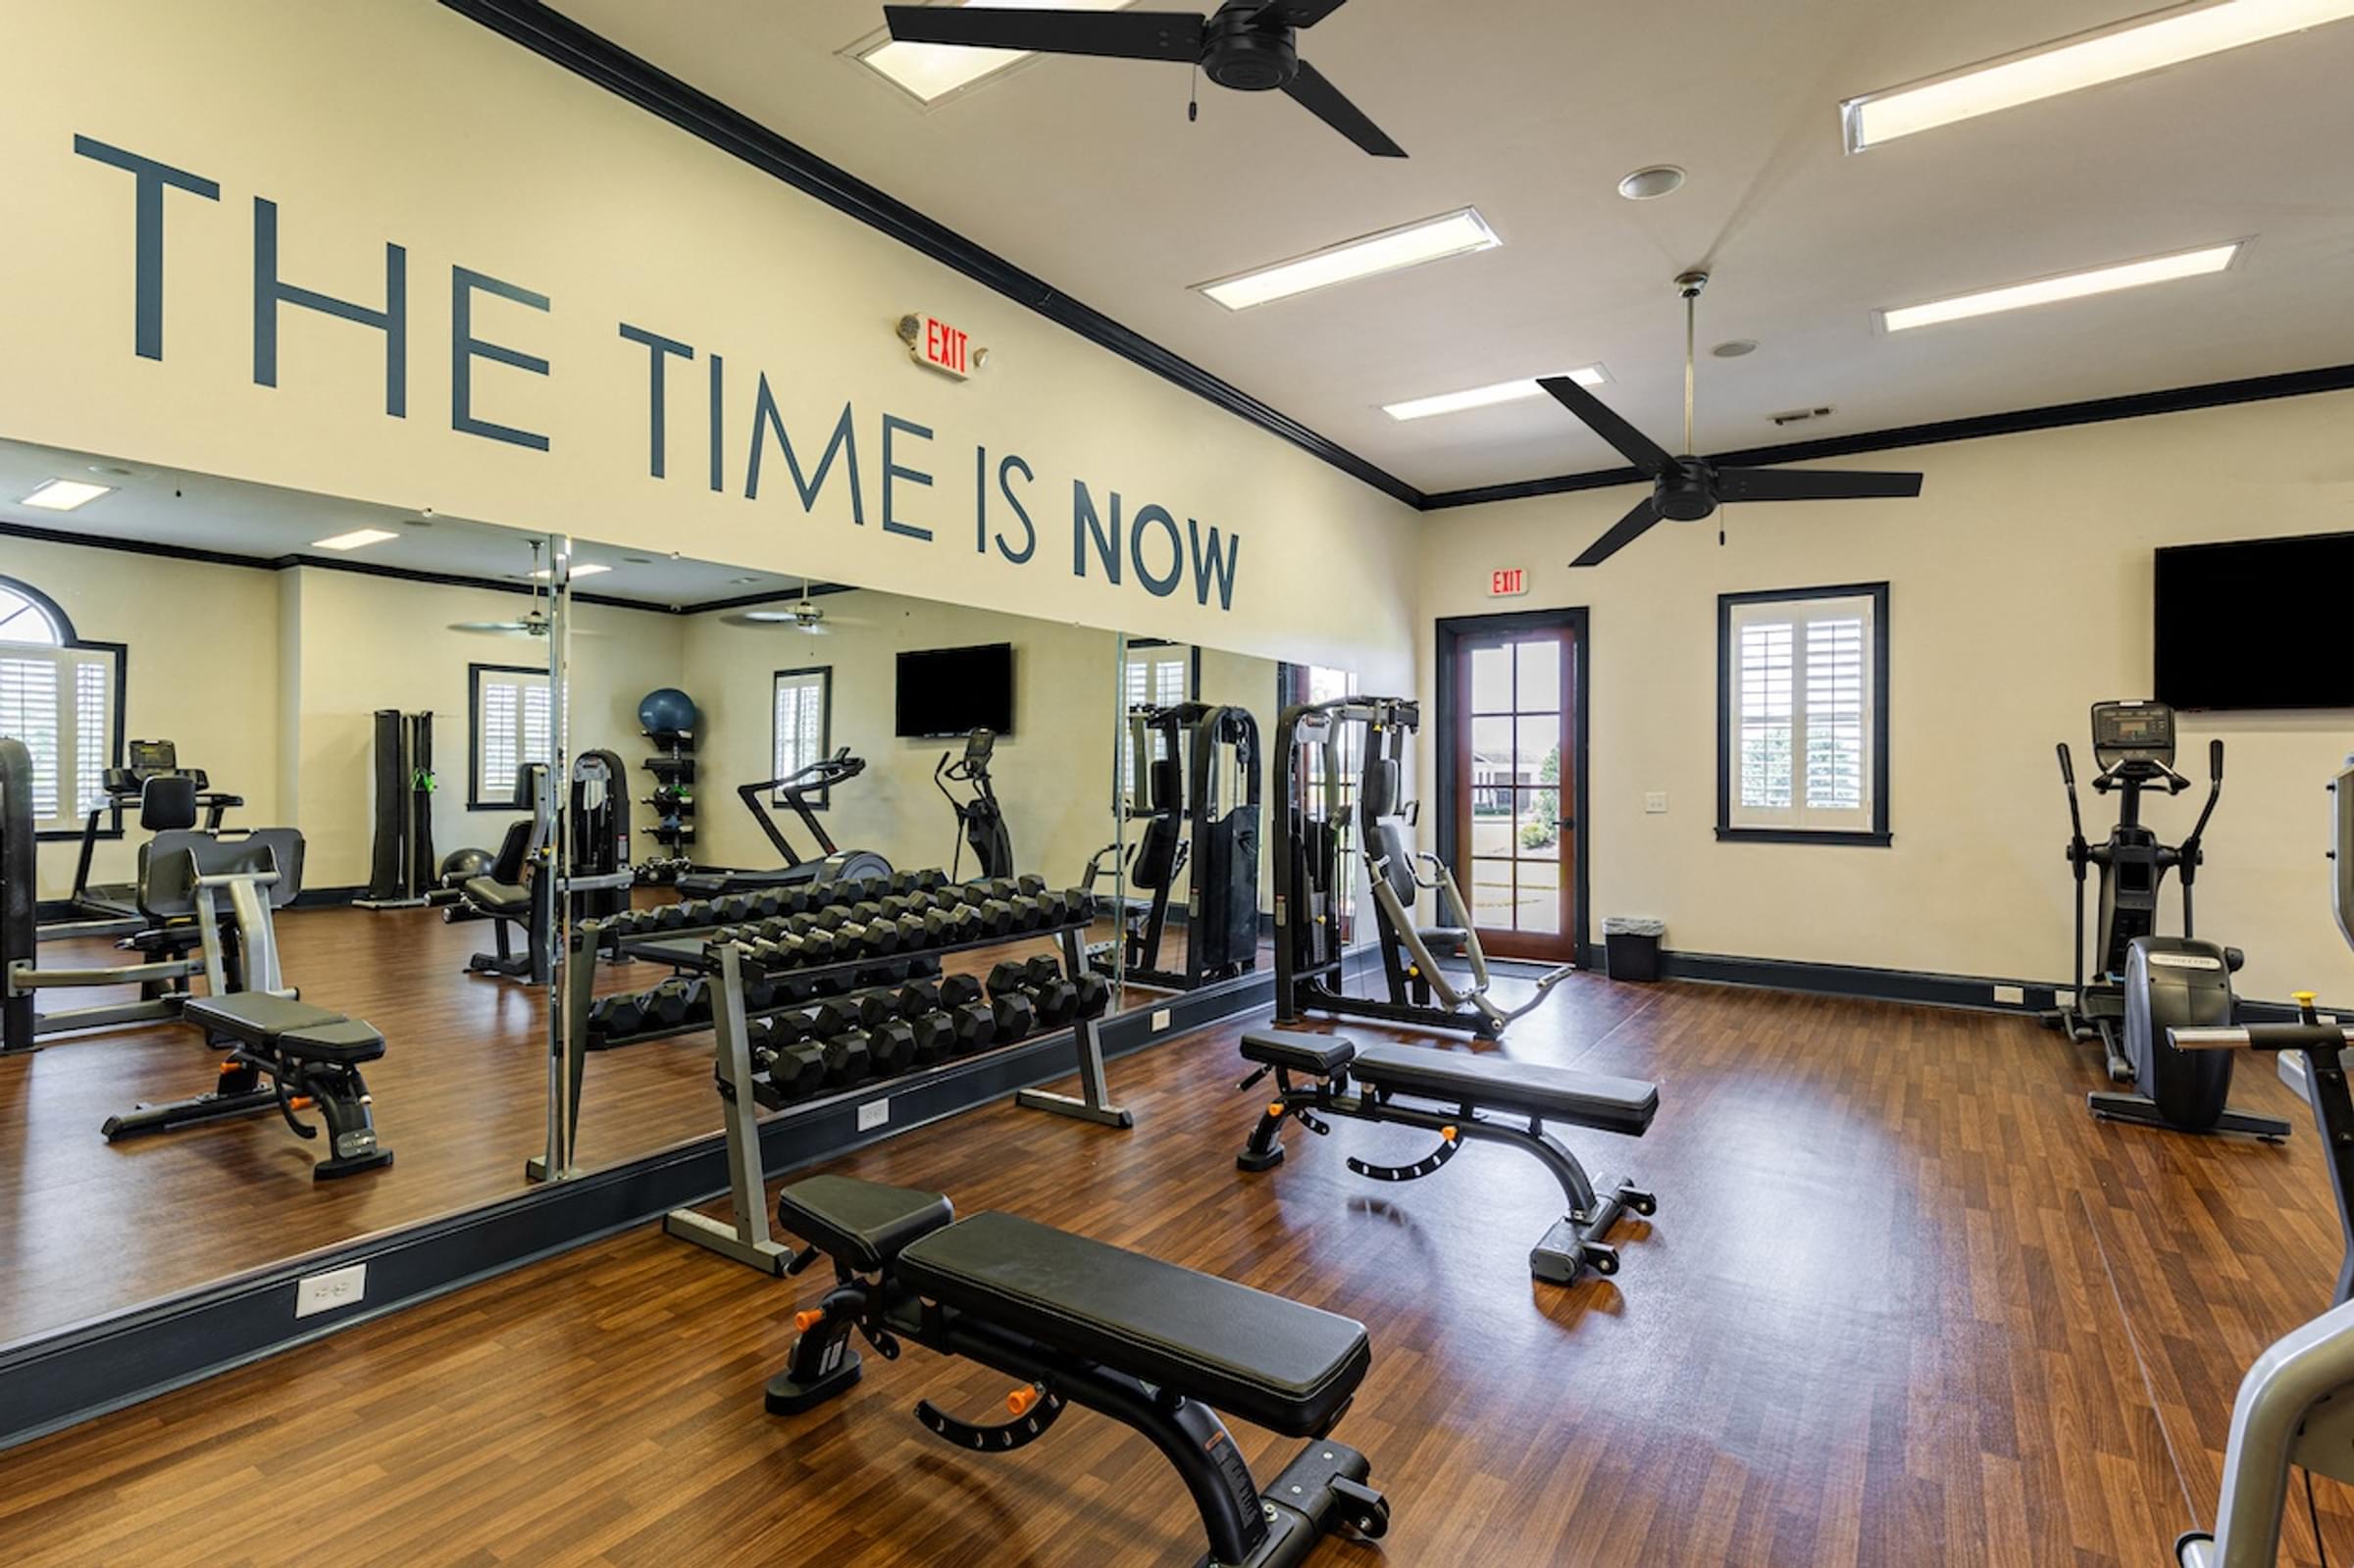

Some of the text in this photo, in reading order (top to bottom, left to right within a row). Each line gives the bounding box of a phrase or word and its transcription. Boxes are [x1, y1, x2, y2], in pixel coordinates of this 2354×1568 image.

[74, 133, 1240, 612] THE TIME IS NOW
[927, 317, 967, 374] EXIT
[1492, 569, 1523, 593] EXIT
